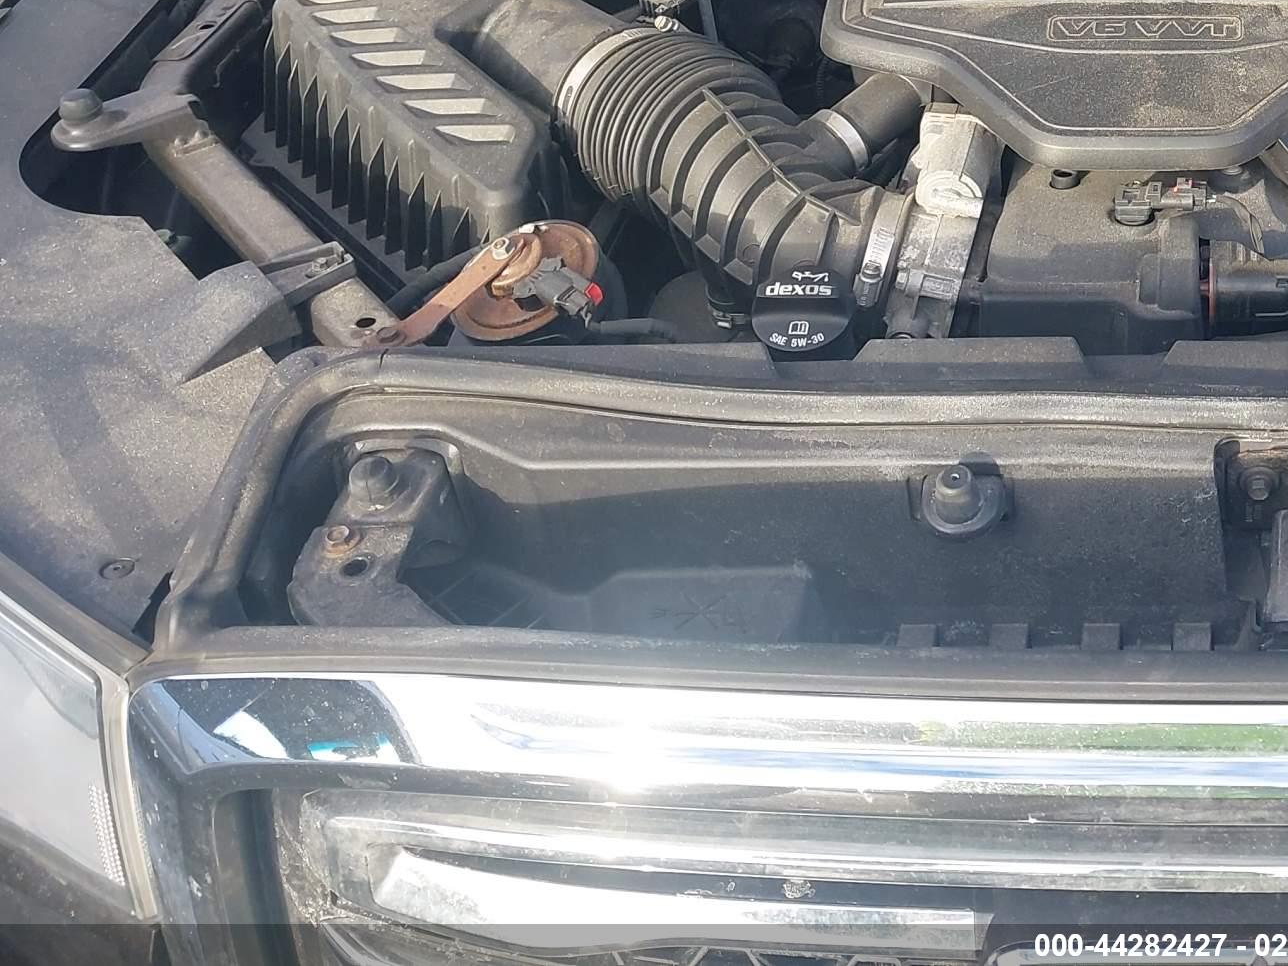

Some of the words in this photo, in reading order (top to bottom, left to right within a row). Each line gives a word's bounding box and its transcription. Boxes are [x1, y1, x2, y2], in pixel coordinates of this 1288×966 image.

[1056, 19, 1127, 37] V6
[1134, 19, 1235, 37] VVT
[765, 282, 833, 296] dexos
[769, 332, 788, 346] SAE
[790, 332, 825, 348] 5W-30
